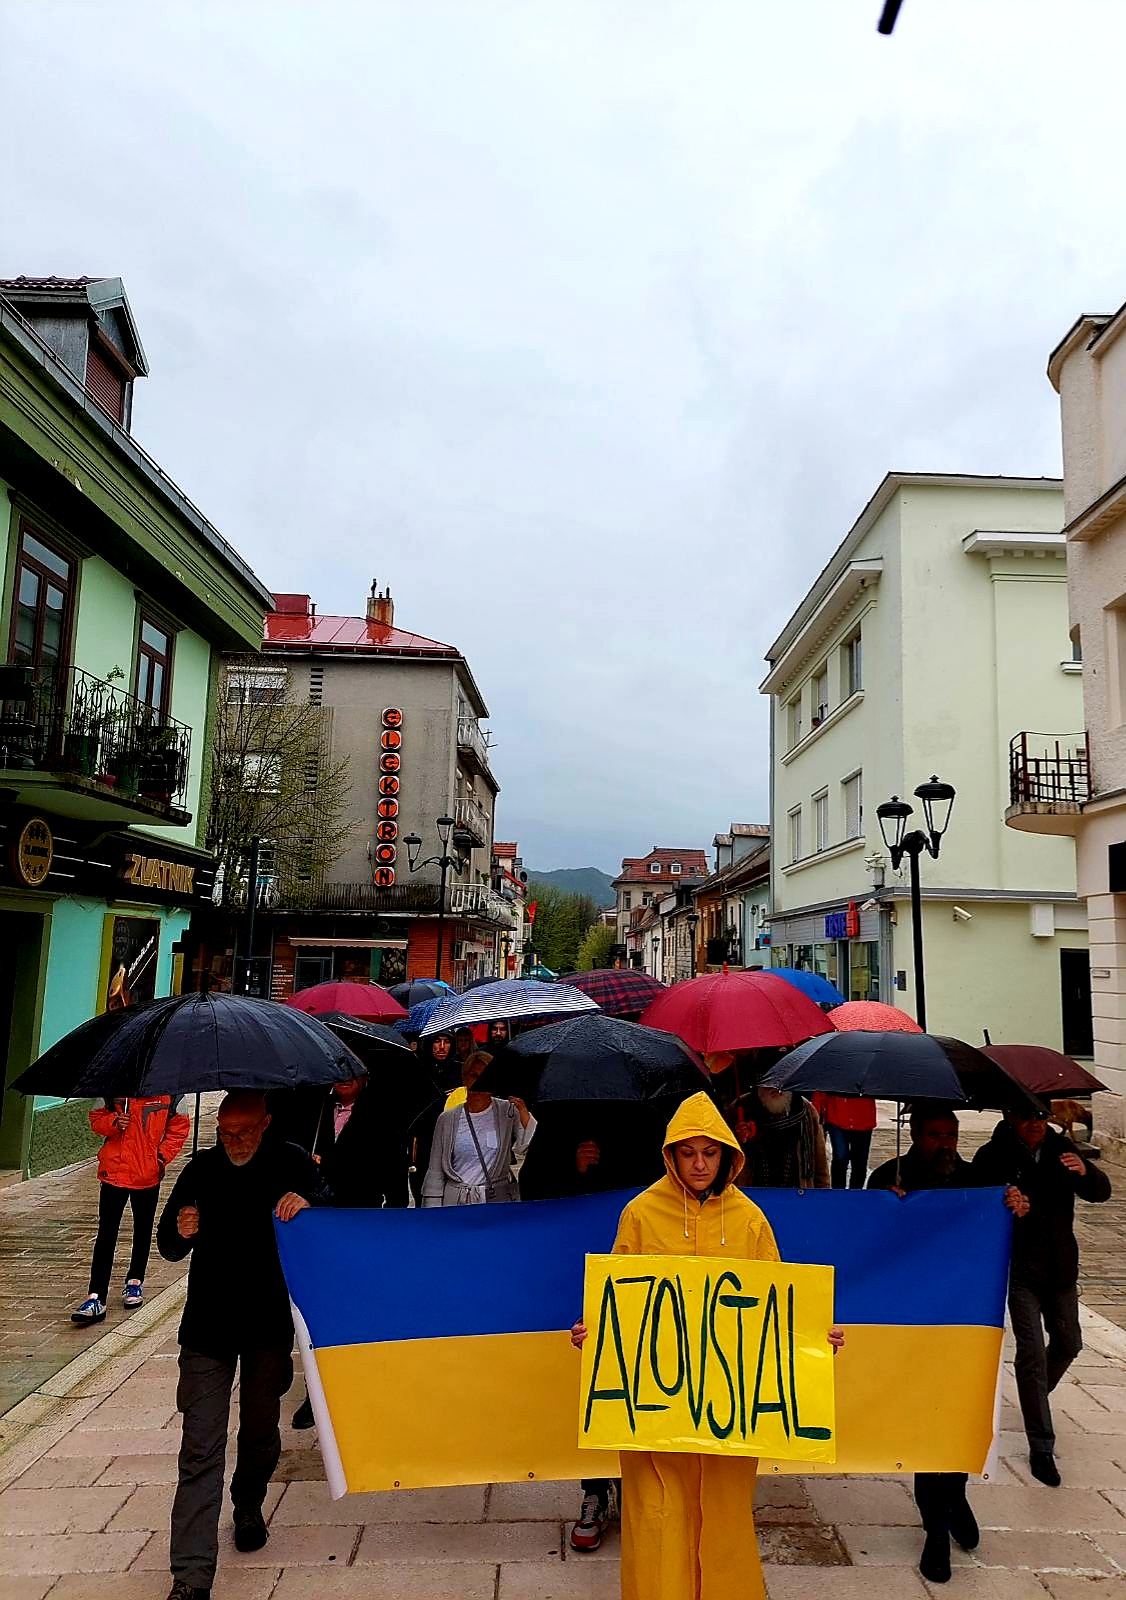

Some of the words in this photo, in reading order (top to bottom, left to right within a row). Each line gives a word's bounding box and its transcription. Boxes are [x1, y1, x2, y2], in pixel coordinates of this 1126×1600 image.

[129, 853, 195, 894] ZLATNIK
[375, 708, 402, 886] ELEKTRON
[584, 1271, 832, 1443] AZOVSTAL
